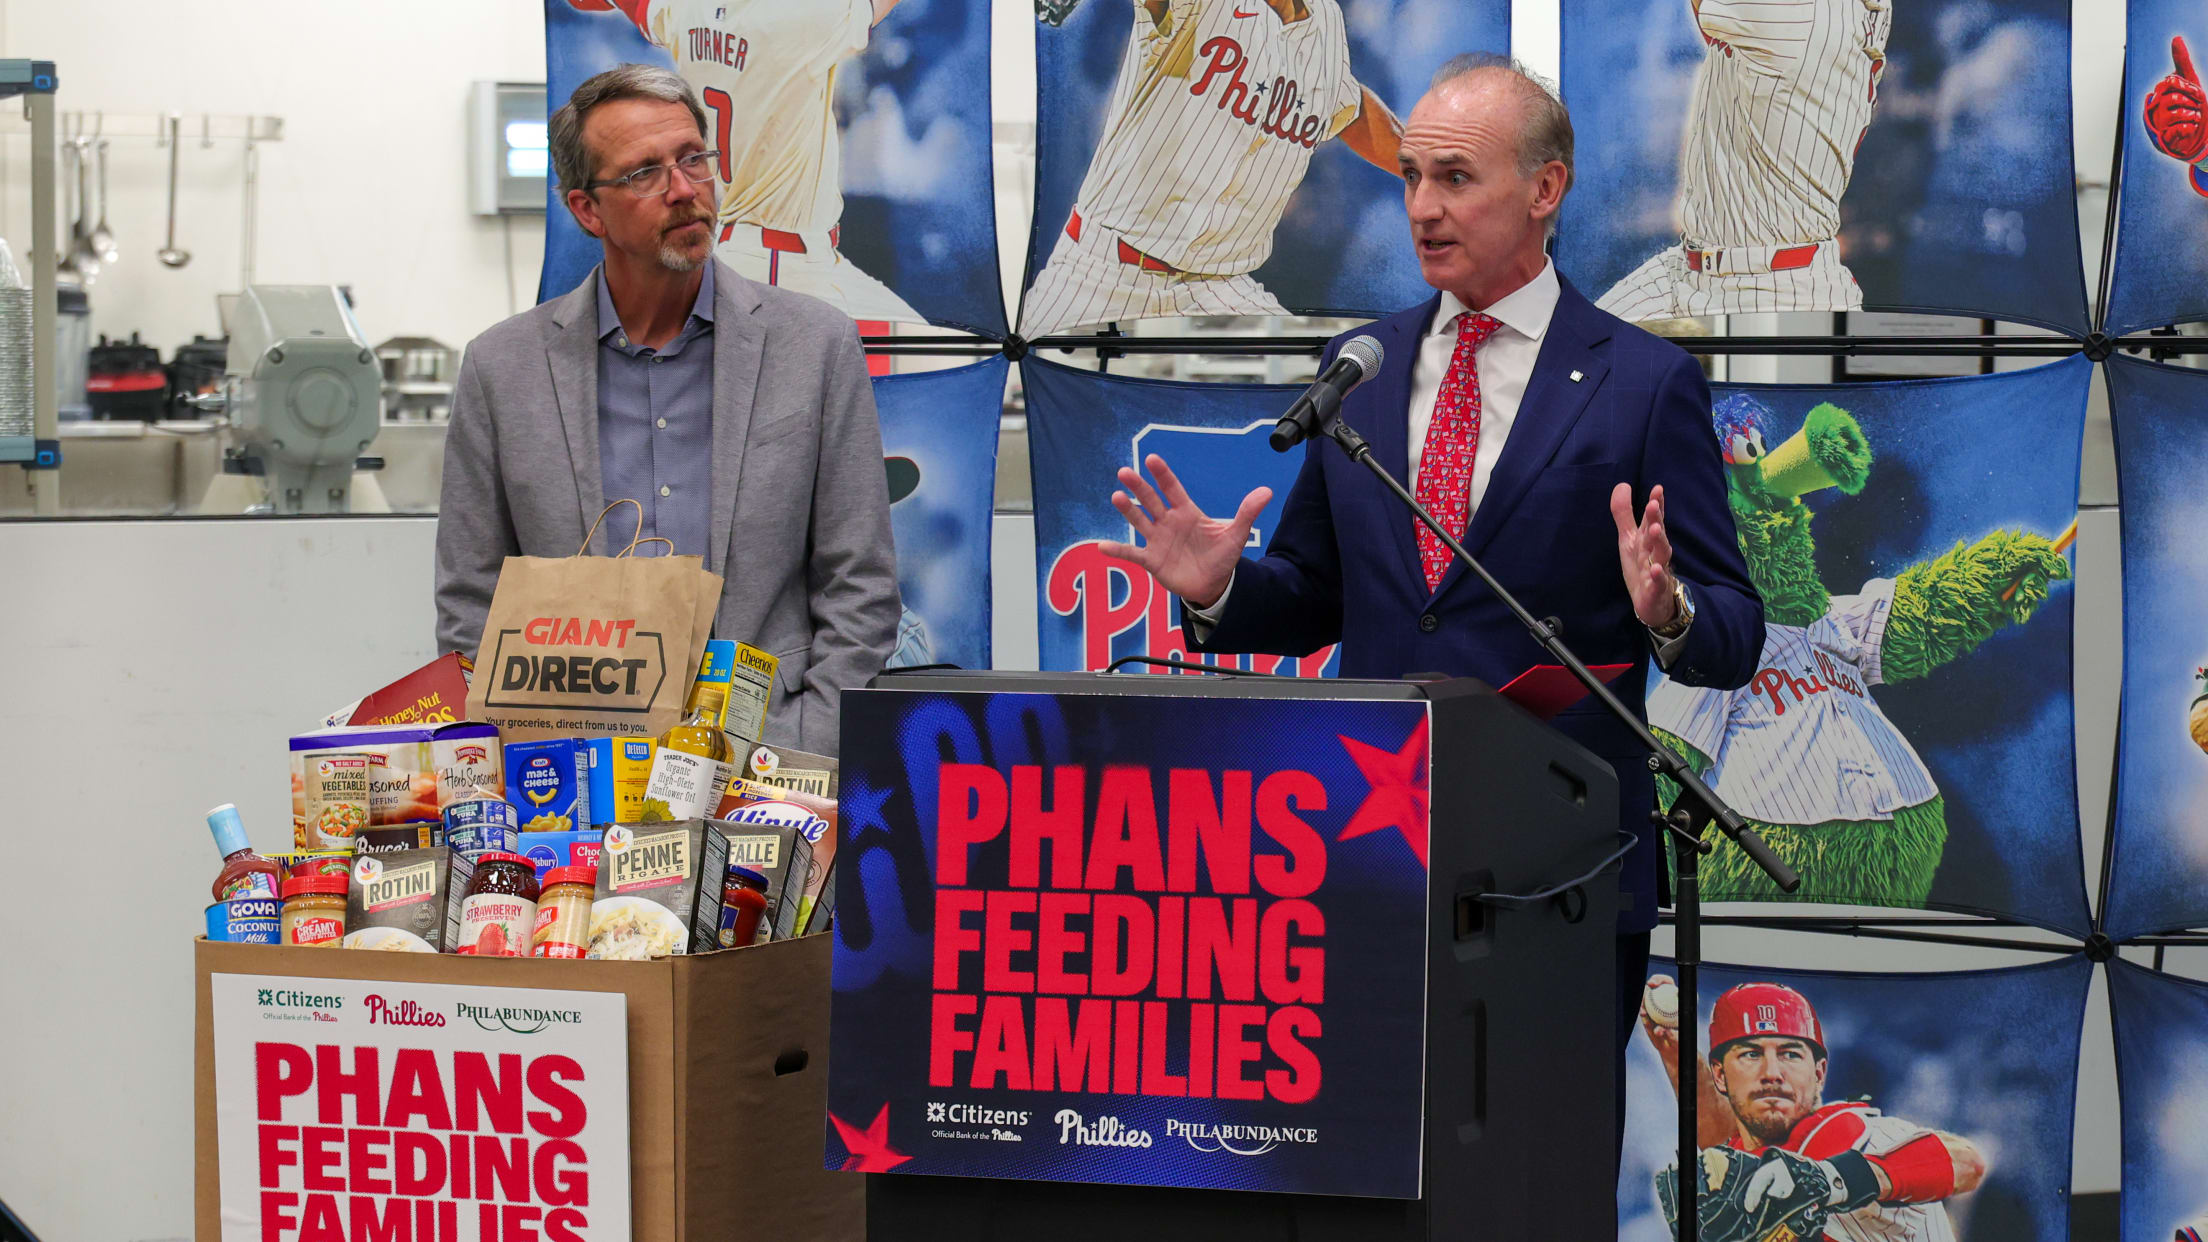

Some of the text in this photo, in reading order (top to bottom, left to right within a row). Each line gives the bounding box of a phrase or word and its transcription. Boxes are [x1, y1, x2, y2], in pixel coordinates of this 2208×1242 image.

[688, 27, 748, 72] TURNER
[1190, 36, 1327, 151] Phillies
[524, 617, 635, 648] GIANT
[740, 648, 772, 674] Cheerios
[1751, 650, 1864, 716] Phillies
[379, 706, 416, 725] Honey
[417, 691, 441, 712] Nut
[508, 718, 553, 729] groceries,
[556, 719, 583, 729] direct
[585, 720, 605, 730] from
[607, 722, 618, 731] us
[619, 722, 629, 731] to
[630, 723, 648, 734] you.
[334, 768, 365, 780] mixed
[445, 767, 498, 788] Herb Seasoned
[666, 761, 691, 776] Organic
[322, 780, 366, 791] VEGETABLES
[369, 774, 411, 793] asoned
[651, 783, 696, 803] Sunflower Oil
[370, 796, 399, 805] UFFING
[936, 762, 1327, 897] PHANS
[617, 841, 683, 874] PENNE
[728, 841, 773, 864] FALLE
[617, 865, 685, 881] RIGATE
[369, 871, 430, 903] ROTINI
[231, 902, 276, 917] GOYA
[466, 904, 522, 921] STRAWBERRY
[227, 922, 280, 934] COCONUT
[243, 933, 269, 944] Milk
[297, 922, 336, 937] CREAMY
[932, 889, 1326, 1004] FEEDING
[276, 990, 582, 1034] Citizens Phillies PHILABUNDANCE
[313, 1011, 338, 1023] Phillies
[1757, 1005, 1776, 1021] 10
[928, 993, 1322, 1104] FAMILIES
[255, 1041, 587, 1139] PHANS
[932, 1129, 955, 1138] Official
[956, 1131, 971, 1139] Bank
[979, 1132, 990, 1140] the
[991, 1128, 1022, 1142] Phillies
[948, 1104, 1318, 1156] Citizens Phillies PHILABUNDANCE
[257, 1123, 589, 1207] FEEDING
[260, 1191, 589, 1242] FAMILIES
